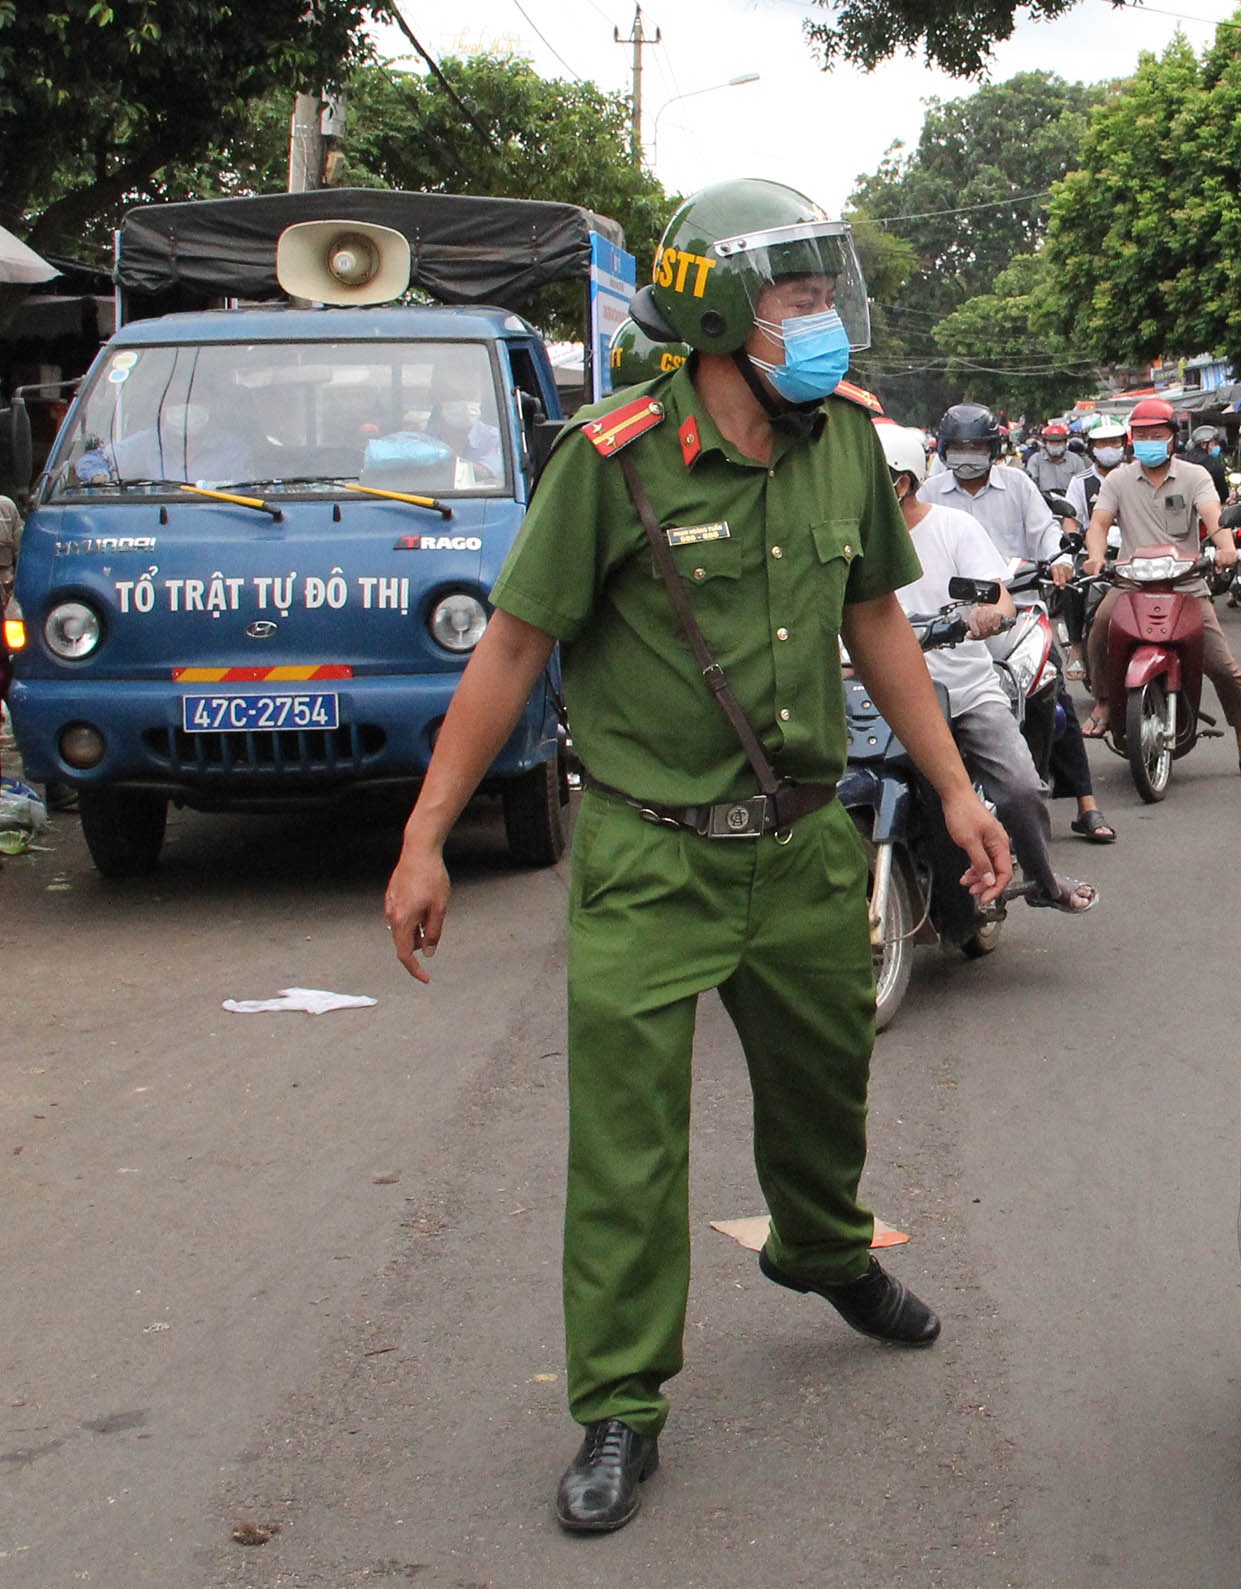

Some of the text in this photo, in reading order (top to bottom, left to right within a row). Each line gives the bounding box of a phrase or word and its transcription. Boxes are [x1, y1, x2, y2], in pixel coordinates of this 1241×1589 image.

[401, 535, 482, 551] TRAGO
[115, 566, 409, 618] TỔ TRẬT TỰ ĐÔ THỊ
[194, 697, 329, 728] 47C-2754
